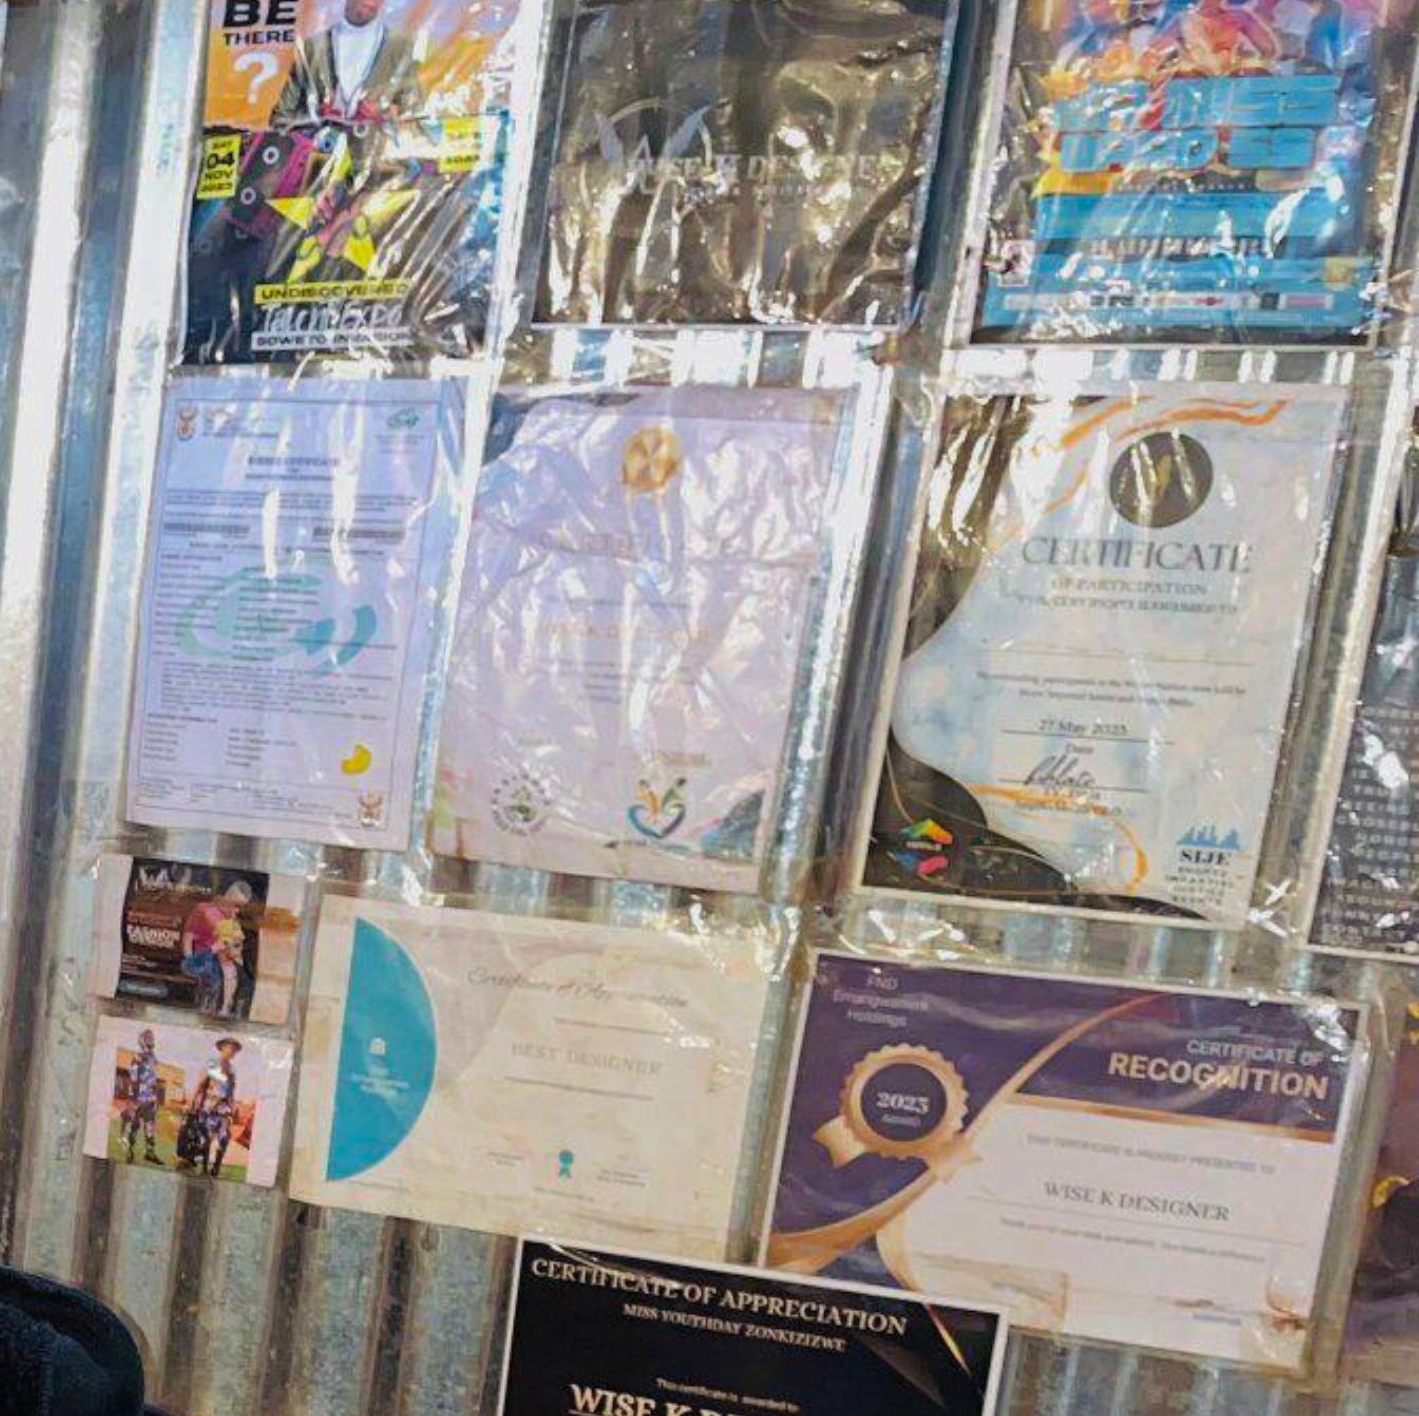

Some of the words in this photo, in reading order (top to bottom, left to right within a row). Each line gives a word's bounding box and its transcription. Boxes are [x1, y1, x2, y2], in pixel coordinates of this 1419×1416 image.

[223, 0, 299, 27] BE
[223, 29, 296, 45] THERE
[207, 152, 235, 169] 04
[1021, 536, 1254, 574] CERTIFICATE
[1186, 1039, 1296, 1064] CERTIFICATE
[1107, 1051, 1330, 1101] RECOGNITION
[1044, 1180, 1094, 1204] WISE
[1098, 1191, 1114, 1207] K
[1118, 1193, 1231, 1222] DESIGNER
[531, 1257, 679, 1300] CERTIFICATE
[683, 1282, 718, 1305] OF
[719, 1287, 908, 1337] APPRECIATION
[622, 1303, 659, 1321] MISS
[660, 1309, 742, 1336] YOUTHDAY
